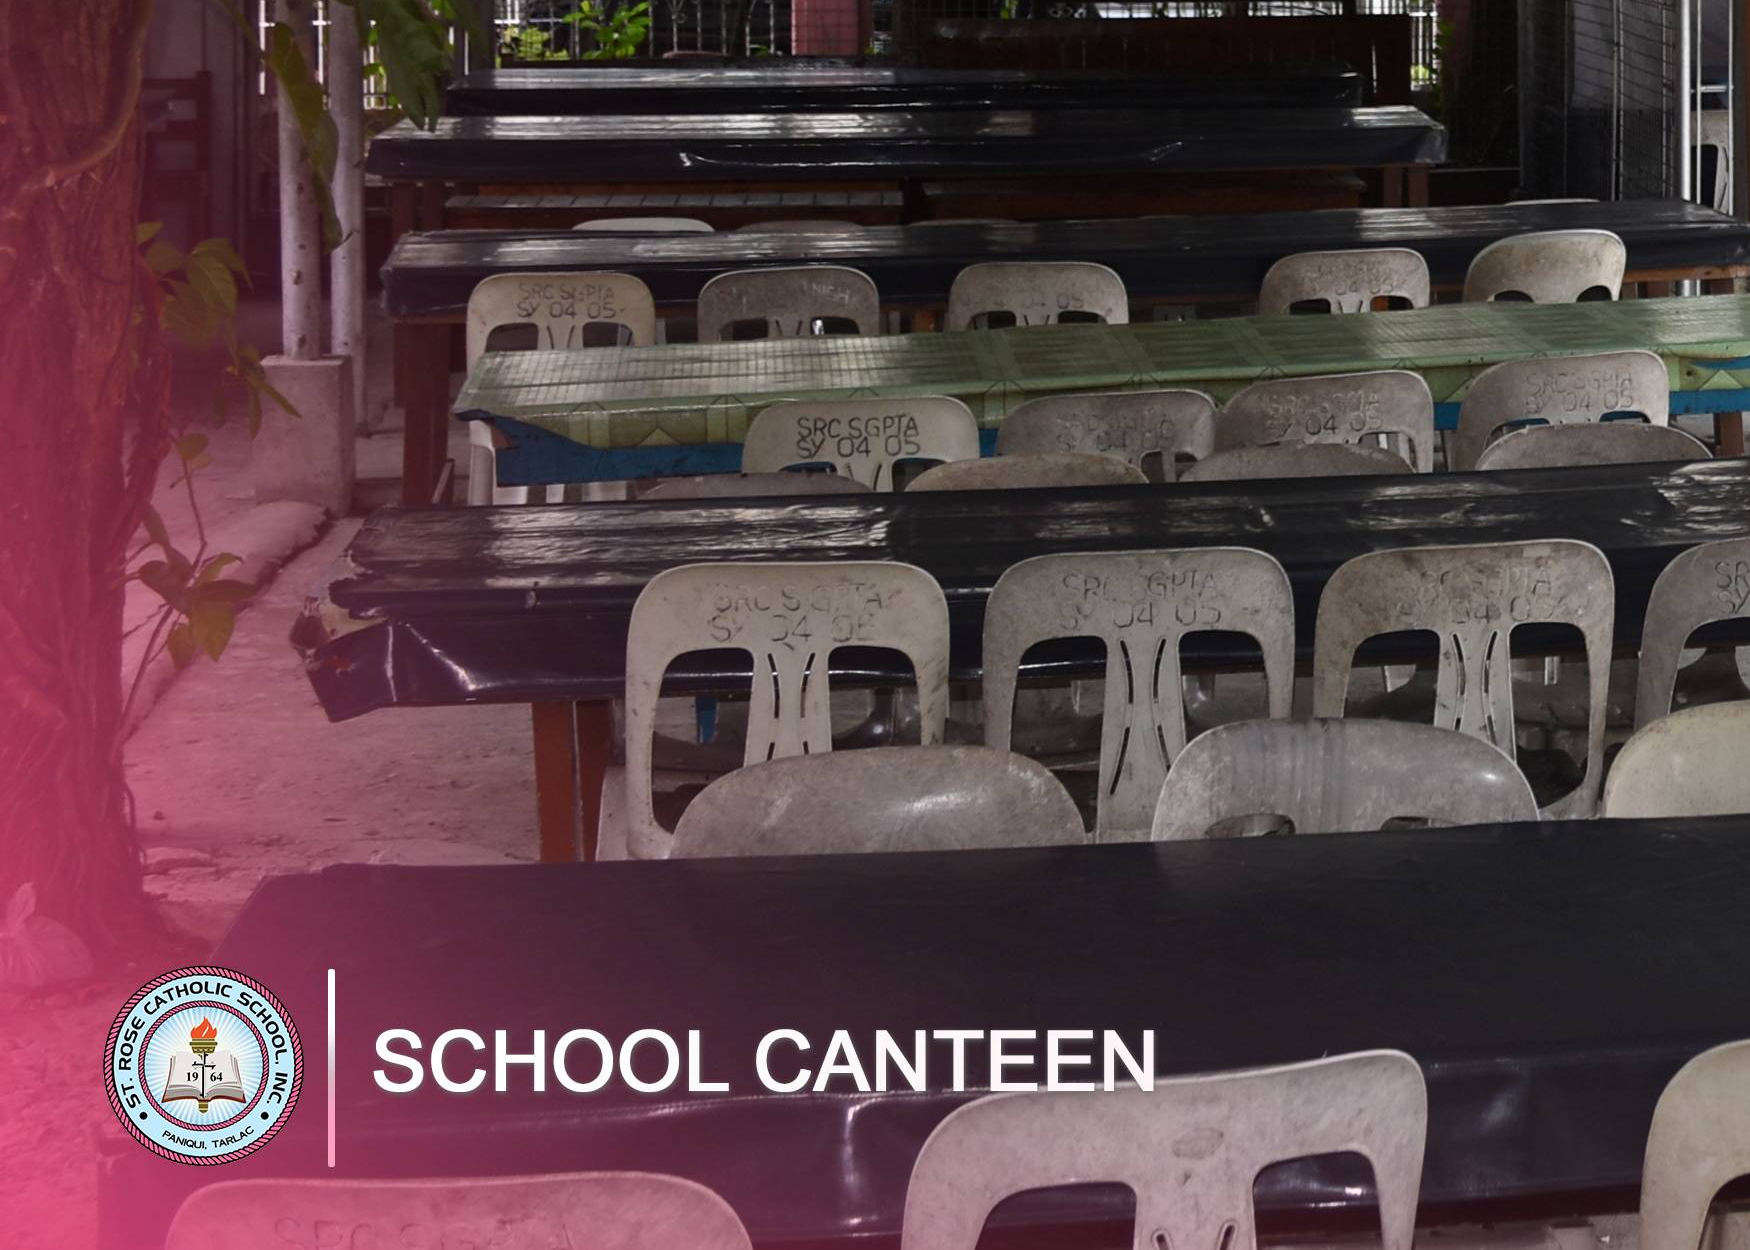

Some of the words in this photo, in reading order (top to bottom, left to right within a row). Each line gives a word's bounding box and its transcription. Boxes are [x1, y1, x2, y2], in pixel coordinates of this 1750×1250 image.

[797, 416, 841, 438] SRC
[796, 436, 827, 459] SY
[837, 436, 872, 458] 04
[885, 435, 921, 457] 05
